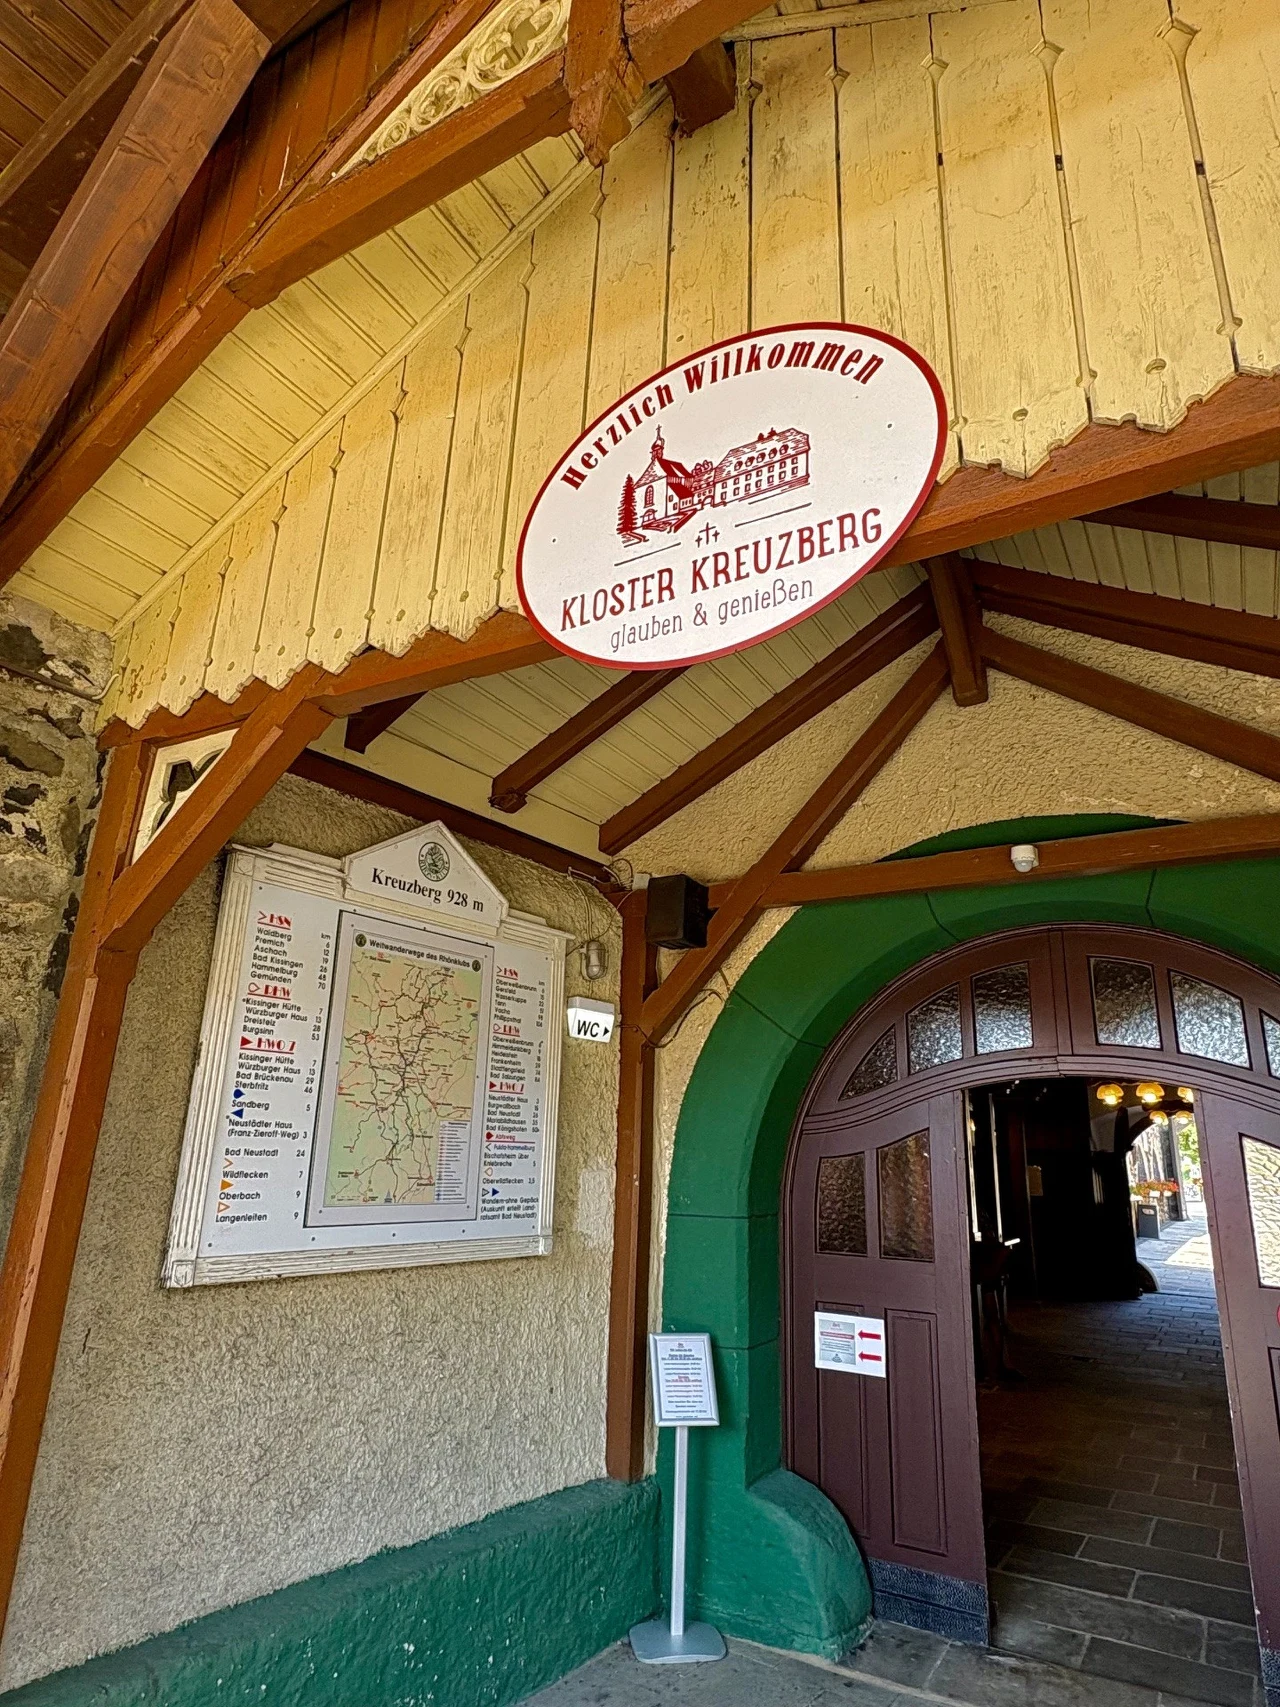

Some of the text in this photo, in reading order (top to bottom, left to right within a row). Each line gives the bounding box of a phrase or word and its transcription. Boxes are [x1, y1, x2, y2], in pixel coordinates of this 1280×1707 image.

[560, 341, 884, 490] Herzlich Willkommen
[560, 507, 882, 632] KLOSTER KREUZBERG
[610, 578, 813, 653] glauben & genießen
[372, 868, 484, 912] Kreuzberg 928 m
[270, 914, 292, 927] HSN
[257, 927, 292, 942] Waldberg
[255, 936, 284, 947] Premich
[254, 944, 287, 957] Aschach
[369, 939, 470, 967] Weitwanderwege des Rhönklubs
[253, 953, 268, 962] Bad
[270, 957, 303, 968] Kissingen
[252, 962, 298, 978] Hammelburg
[250, 971, 326, 990] Gemünden 70
[496, 986, 516, 995] Gersfeld
[495, 993, 527, 1003] Wasserkuppe
[246, 998, 279, 1009] Kissinger
[282, 1002, 301, 1012] Hütte
[495, 1007, 510, 1015] Vacha
[246, 1006, 288, 1019] Würzburger
[291, 1014, 308, 1022] Haus
[244, 1016, 276, 1026] Dreistelz
[242, 1025, 274, 1036] Burgsinn
[577, 1020, 600, 1038] WC
[238, 1053, 272, 1063] Kissinger
[275, 1055, 294, 1065] Hütte
[238, 1062, 315, 1076] Würzburger Haus 13
[236, 1071, 251, 1080] Bad
[254, 1073, 293, 1083] Brückenau
[235, 1081, 269, 1090] Sterbfritz
[488, 1094, 516, 1102] Neustädter
[232, 1100, 270, 1110] Sandberg
[488, 1102, 520, 1110] Burgwallbach
[229, 1119, 292, 1129] Neustädter Haus
[225, 1148, 241, 1156] Bad
[222, 1170, 268, 1178] Wildflecken
[219, 1191, 300, 1200] Oberbach 9
[216, 1212, 298, 1224] Langenleiten 9
